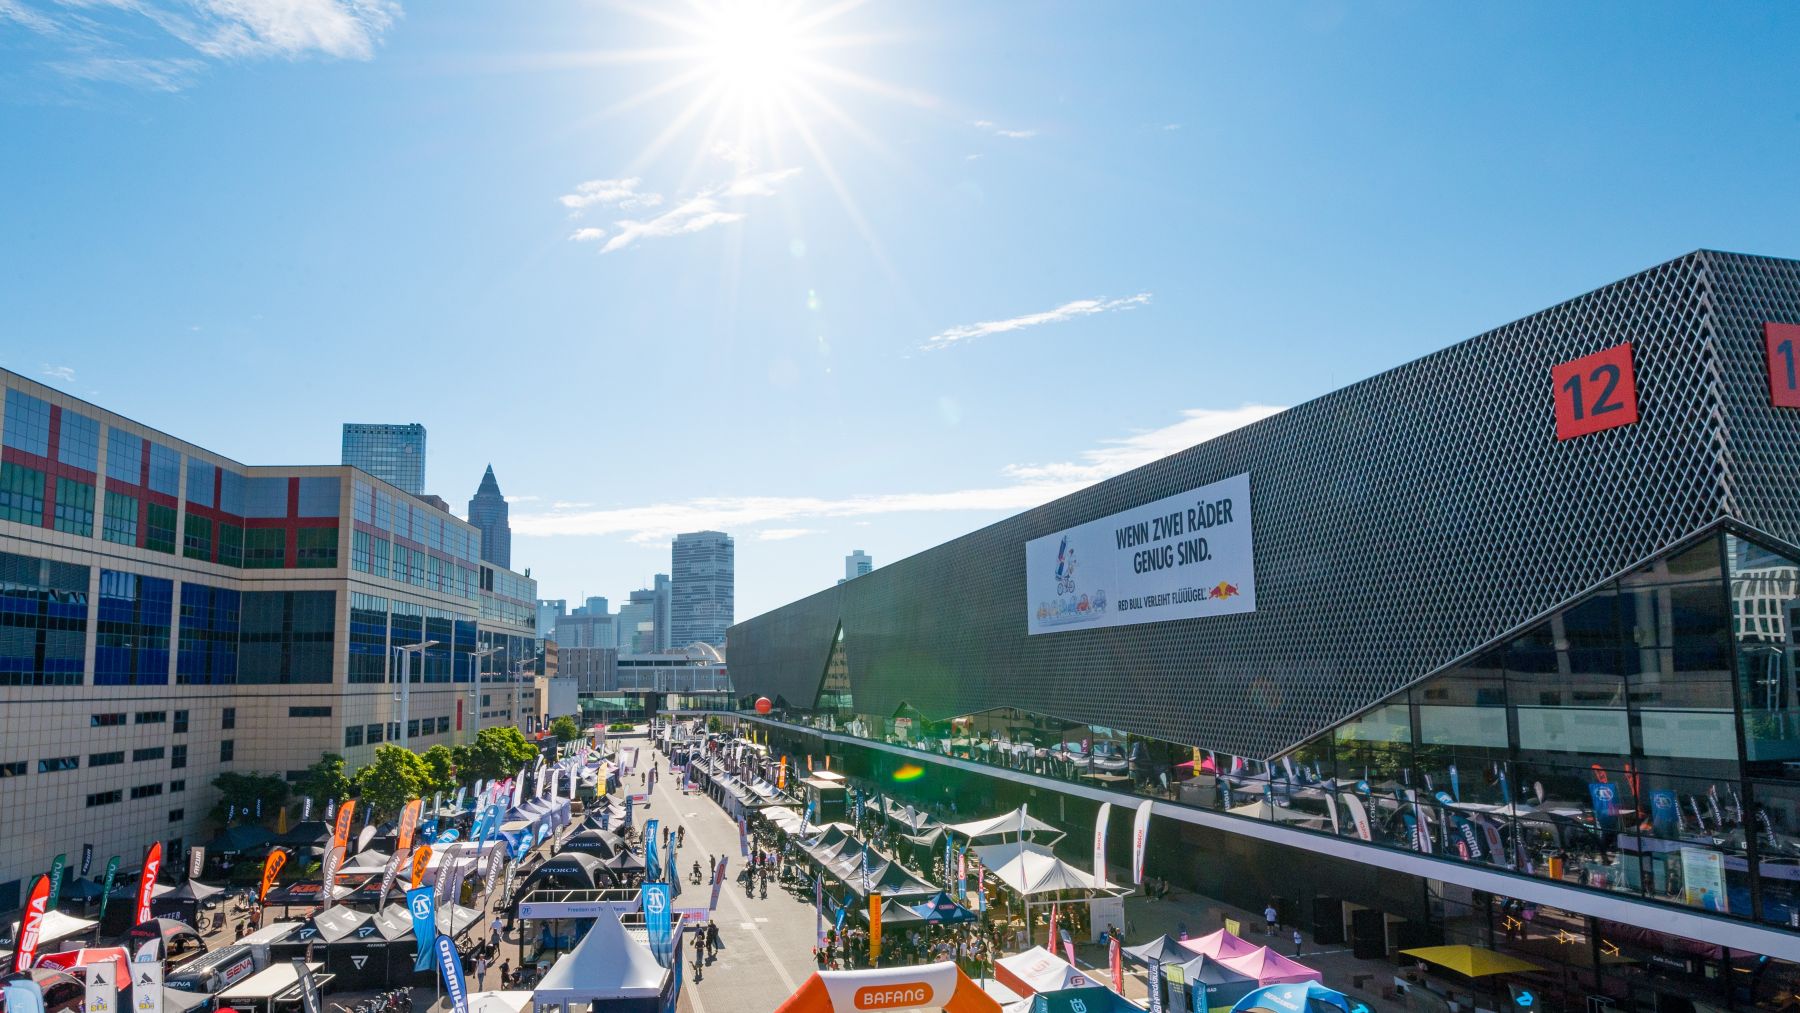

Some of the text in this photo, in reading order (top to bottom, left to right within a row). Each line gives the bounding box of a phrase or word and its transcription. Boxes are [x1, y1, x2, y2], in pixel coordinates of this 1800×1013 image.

[1563, 364, 1624, 421] 12
[1116, 498, 1233, 550] WENN ZWEI RÄDER
[1133, 537, 1212, 574] GENUG SIND.
[1118, 599, 1129, 612] RED
[1129, 597, 1142, 610] BULL
[1143, 593, 1171, 608] VERLEIHT
[266, 854, 284, 882] KTM
[414, 849, 430, 881] KTM
[139, 859, 160, 923] SENA
[18, 895, 49, 971] SENA
[226, 958, 252, 980] SENA
[863, 987, 925, 1005] BAFANG
